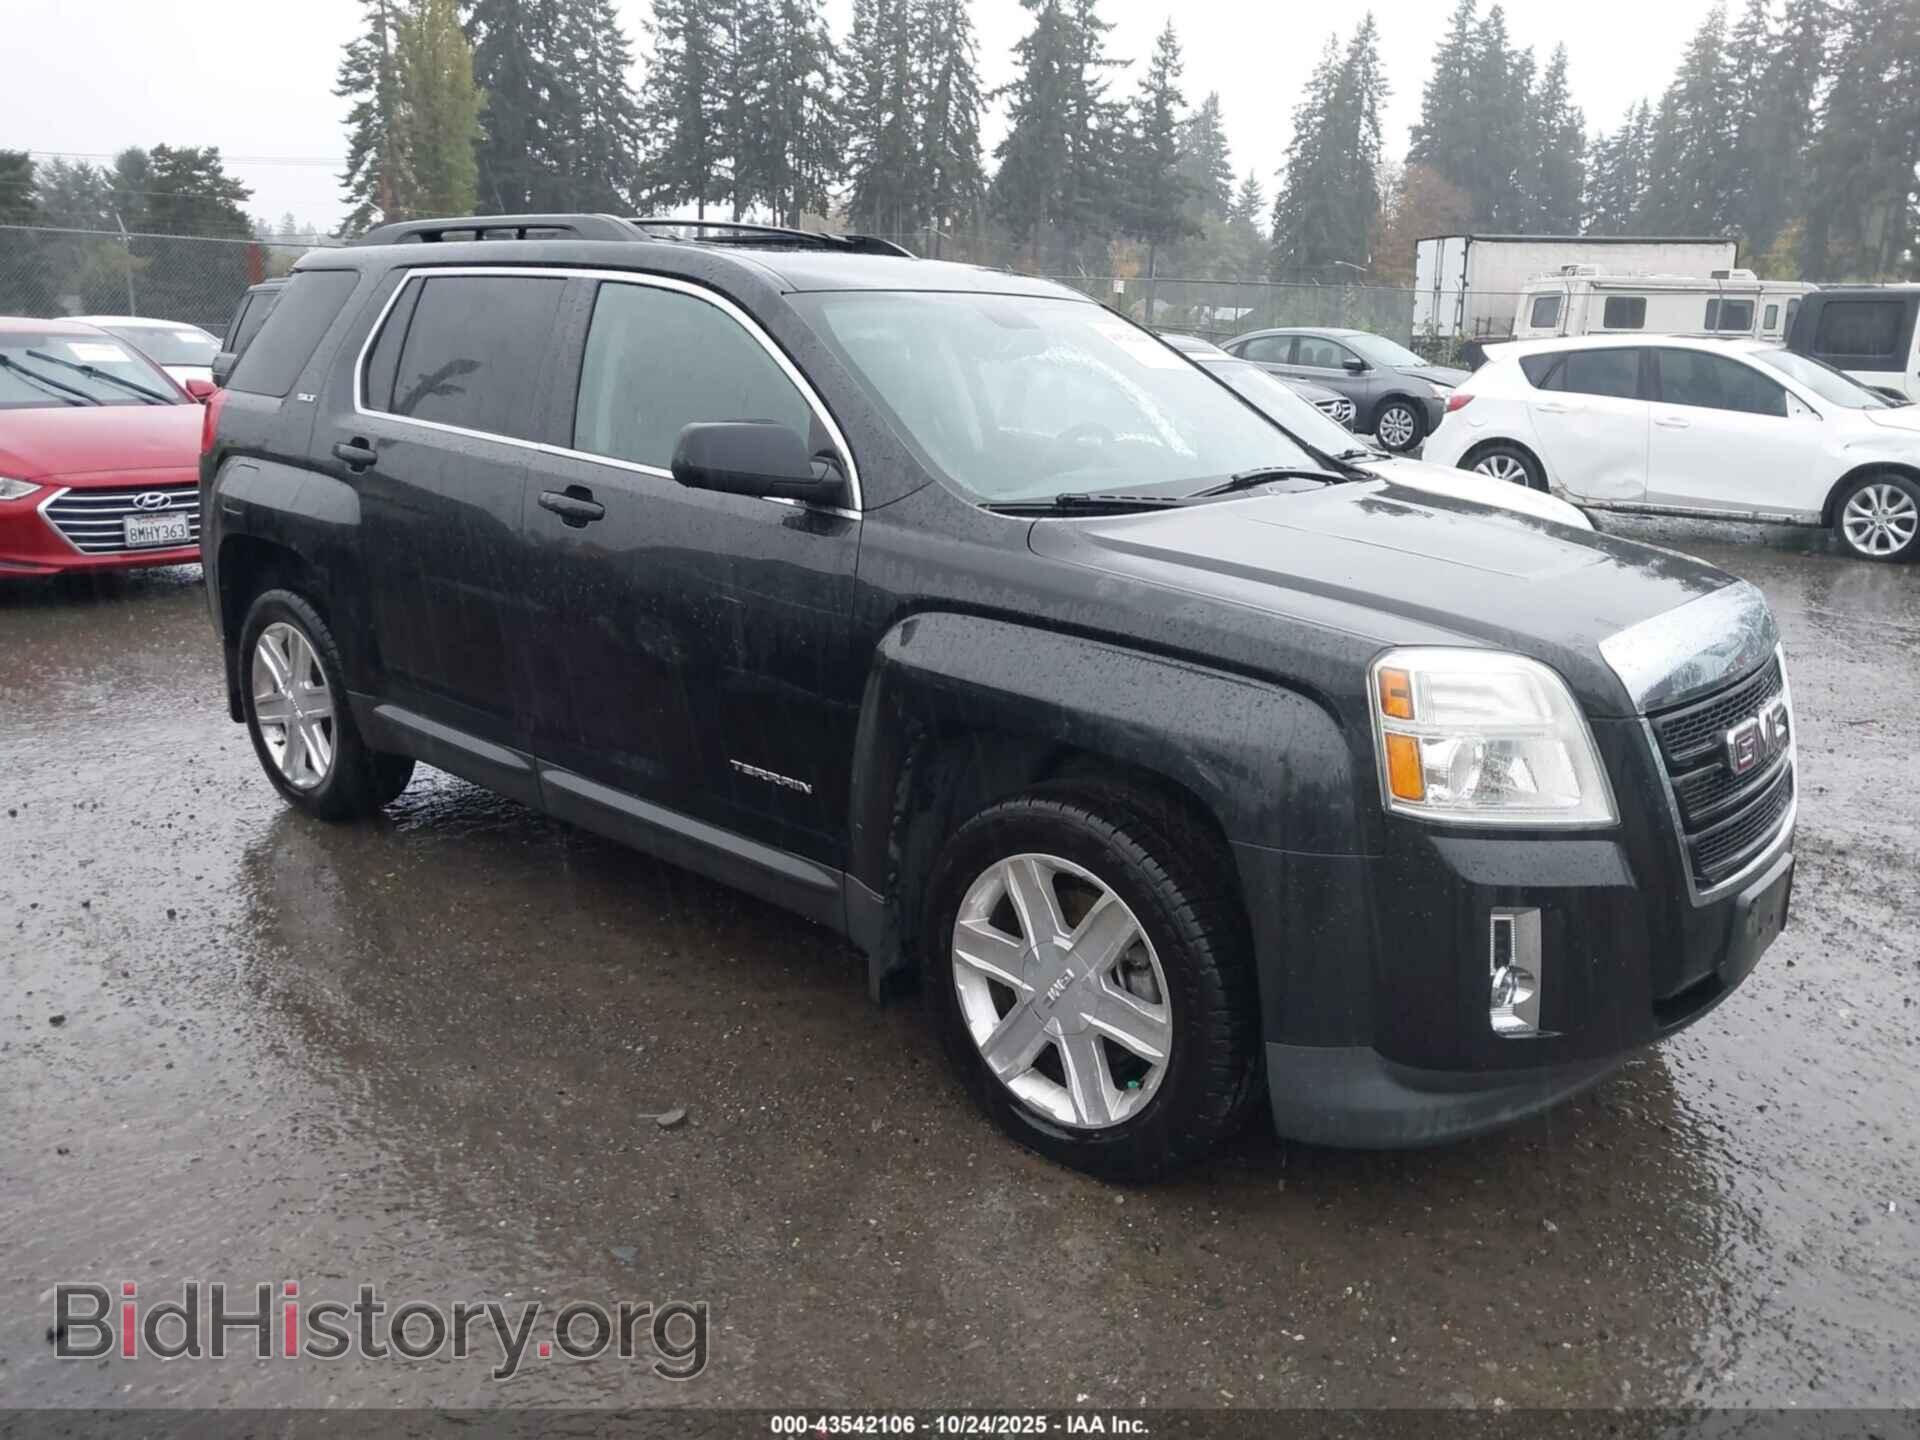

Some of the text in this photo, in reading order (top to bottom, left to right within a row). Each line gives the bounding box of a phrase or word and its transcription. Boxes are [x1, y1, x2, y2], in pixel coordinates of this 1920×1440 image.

[129, 524, 186, 541] 8MHY363
[1727, 699, 1790, 775] GMC
[730, 759, 812, 794] TERRAIN
